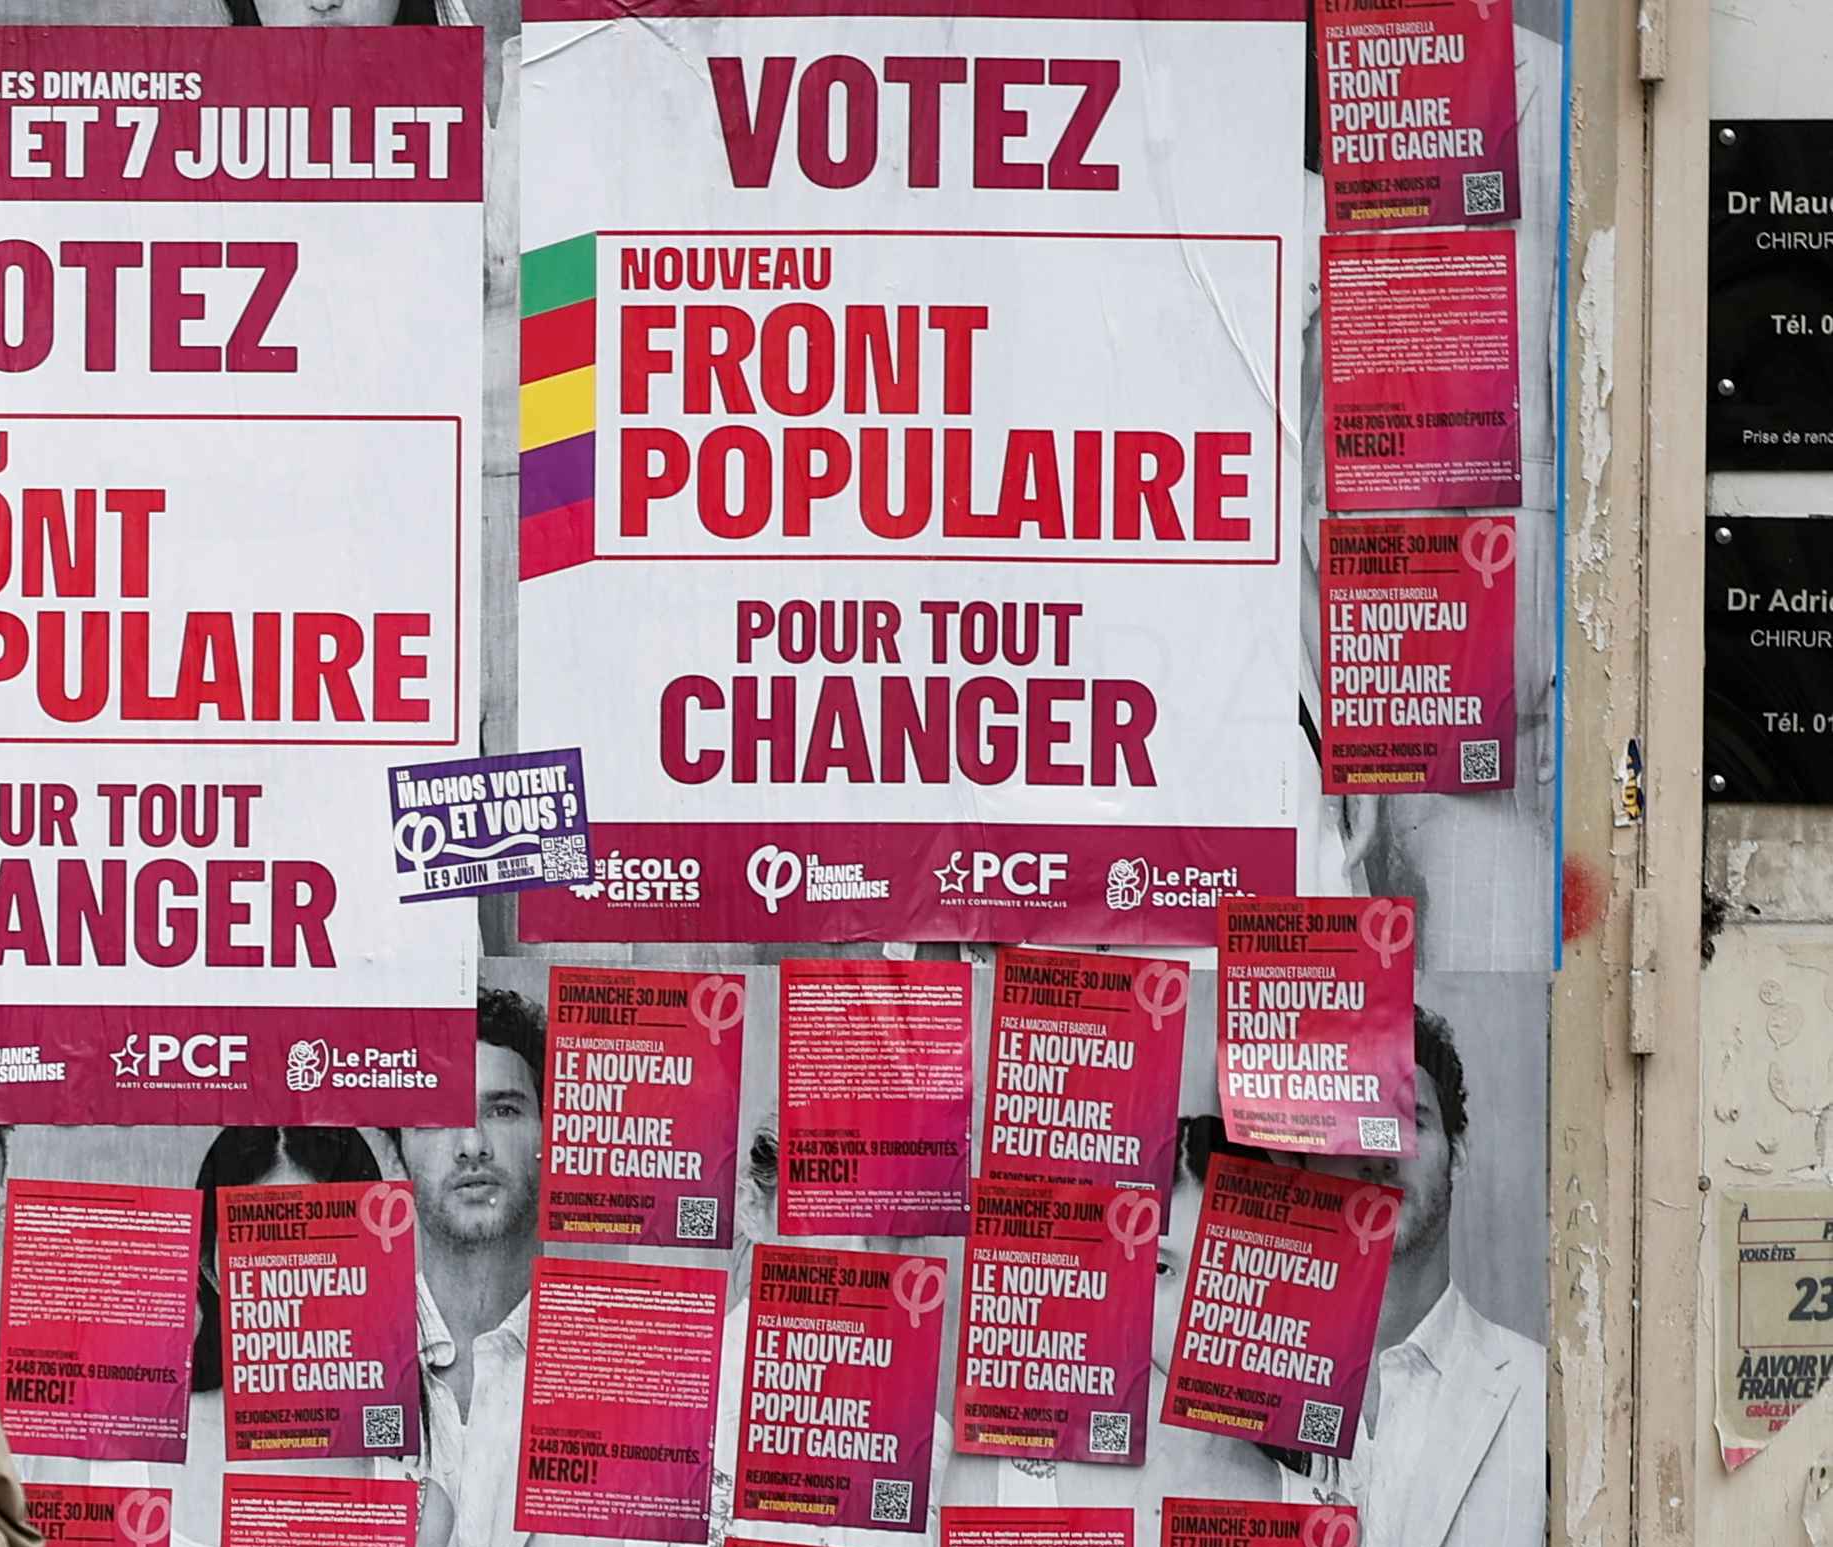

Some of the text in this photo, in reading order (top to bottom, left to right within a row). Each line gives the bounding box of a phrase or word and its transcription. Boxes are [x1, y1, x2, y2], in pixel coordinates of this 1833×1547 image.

[44, 72, 201, 100] DIMANCHES
[11, 106, 98, 177] ET
[117, 107, 158, 177] 7
[175, 107, 462, 179] JUILLET
[707, 55, 1120, 191] VOTEZ
[1729, 192, 1760, 214] Dr
[621, 247, 831, 291] NOUVEAU
[1771, 315, 1813, 334] Tél.
[621, 303, 988, 416] FRONT
[1743, 430, 1800, 443] Prise de
[620, 425, 1251, 541] POPULAIRE
[1728, 588, 1760, 611] Dr
[737, 600, 1082, 666] POUR TOUT
[660, 675, 1157, 787] CHANGER
[1763, 713, 1804, 732] Tél.
[397, 766, 574, 808] MACHOS VOTENT.
[98, 784, 262, 848] TOUT
[450, 794, 577, 839] ET VOUS ?
[424, 863, 488, 890] LE 9 JUIN
[149, 1035, 247, 1077] PCF
[333, 1048, 416, 1067] Le Parti
[333, 1069, 437, 1088] socialiste
